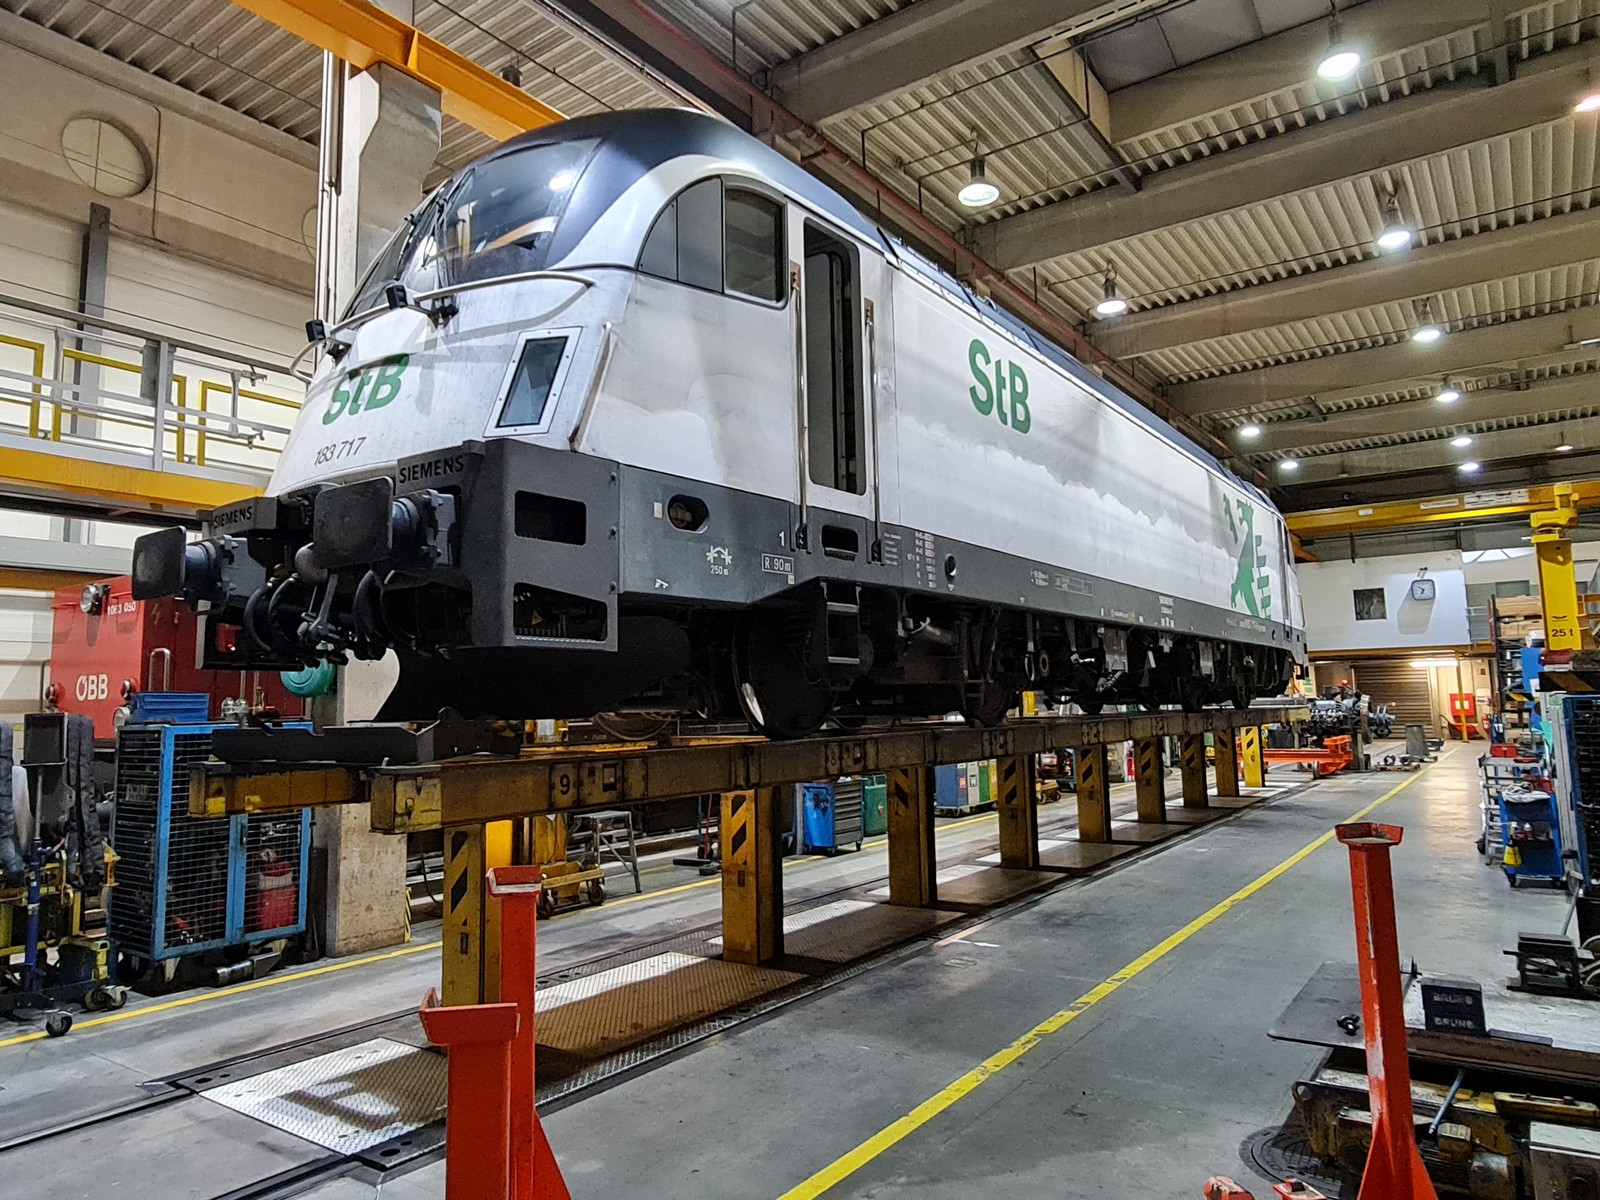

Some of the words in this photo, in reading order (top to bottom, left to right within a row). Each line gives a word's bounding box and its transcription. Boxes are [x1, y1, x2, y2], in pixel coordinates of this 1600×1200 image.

[321, 352, 410, 426] StB
[968, 338, 1031, 434] StB
[314, 443, 337, 466] 183
[336, 436, 367, 460] 717
[399, 455, 465, 484] SIEMENS
[213, 506, 253, 529] SIEMENS
[778, 530, 786, 547] 1
[764, 556, 771, 569] R
[1551, 628, 1567, 638] 25
[76, 673, 109, 701] ÖBB
[559, 773, 571, 796] 9
